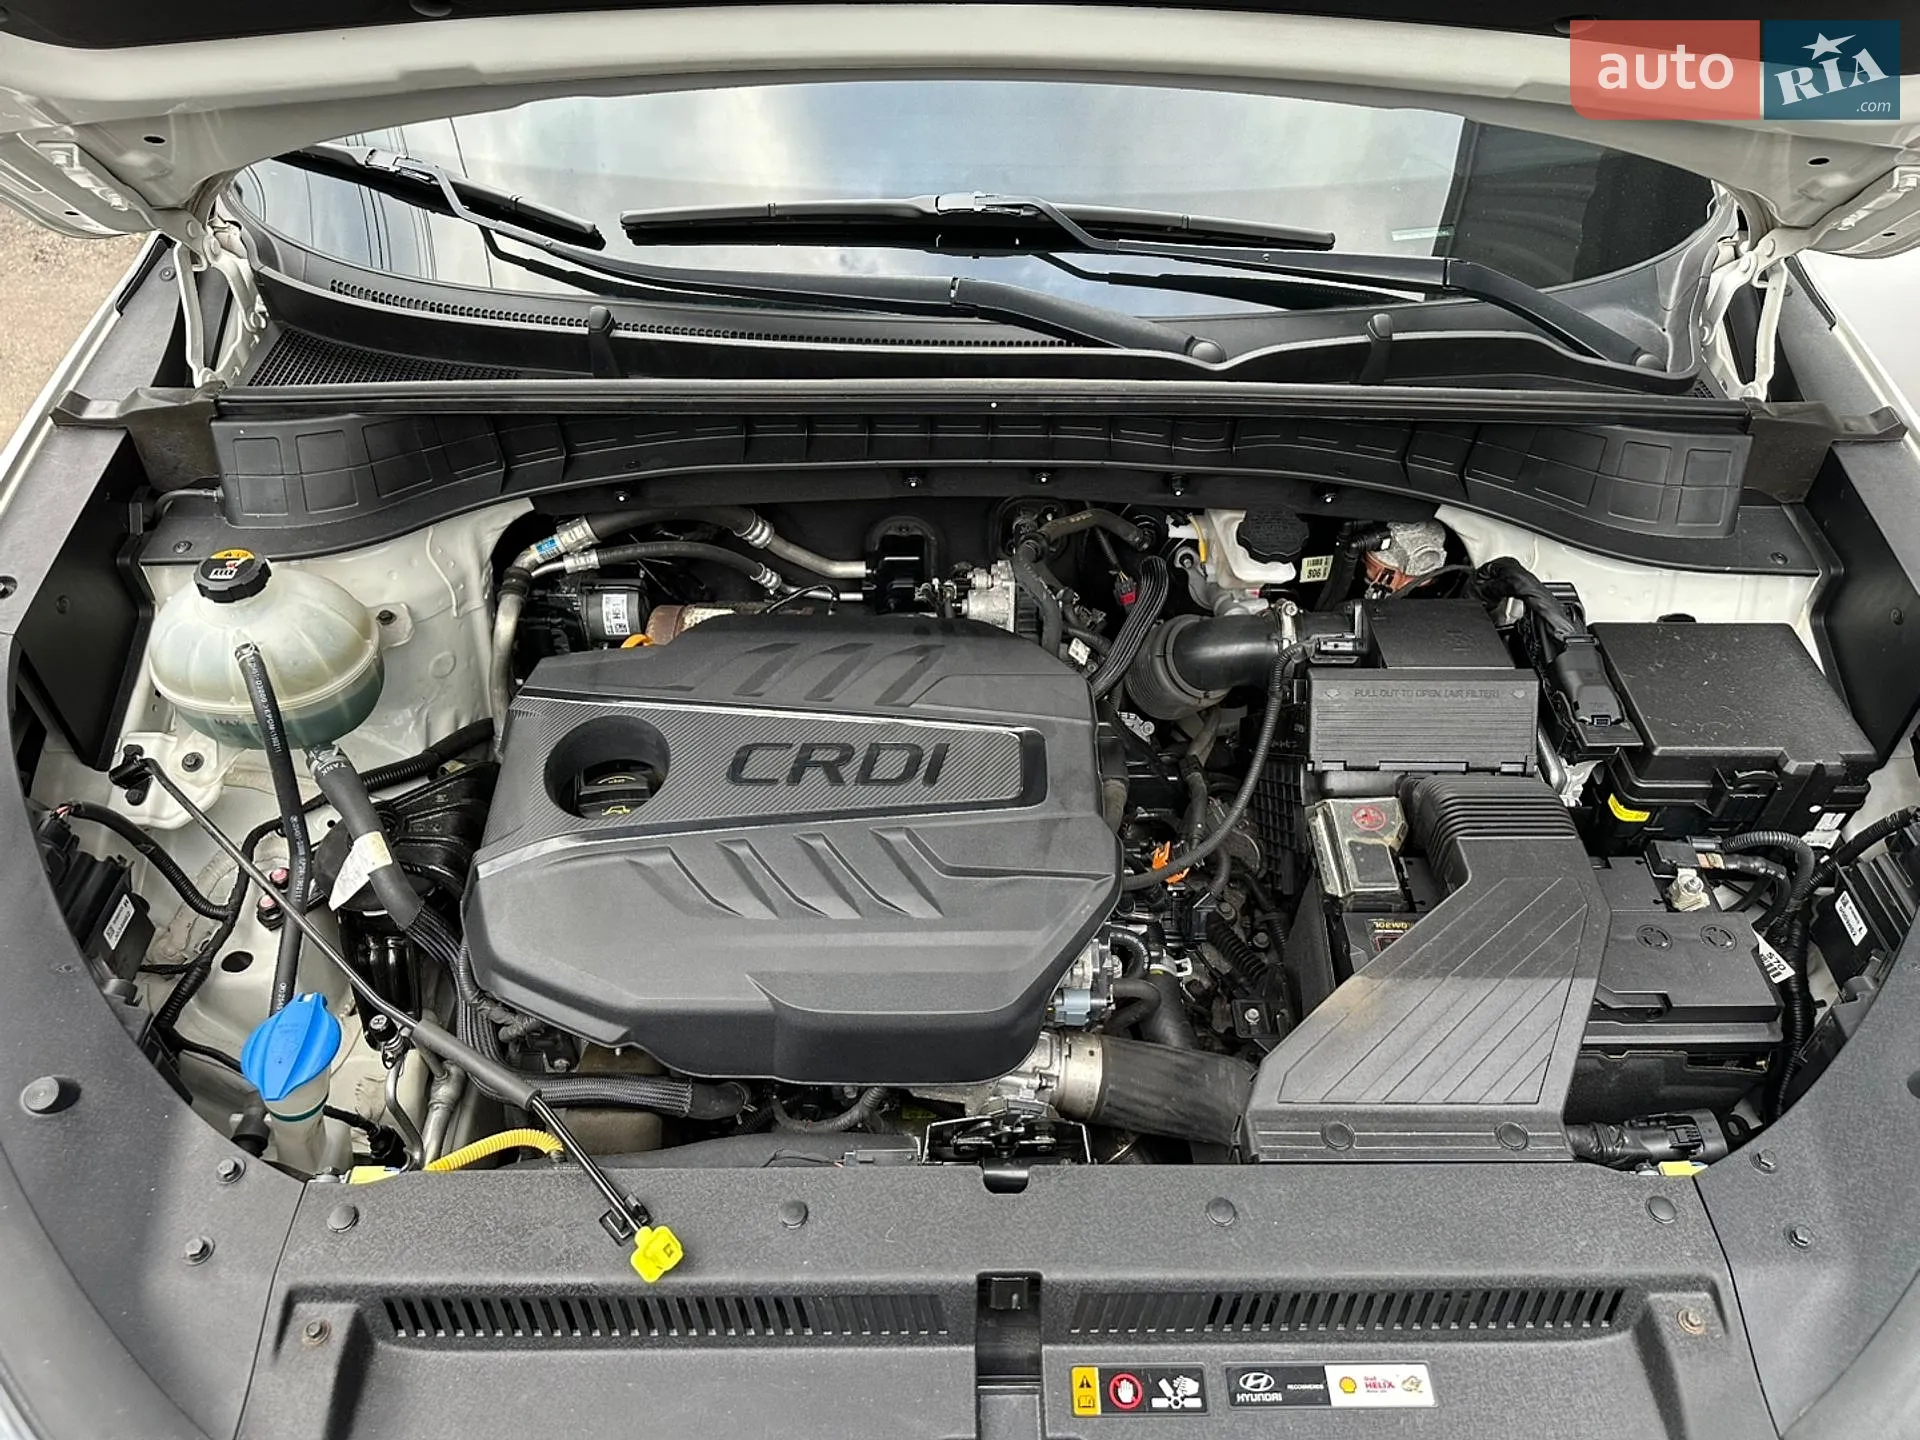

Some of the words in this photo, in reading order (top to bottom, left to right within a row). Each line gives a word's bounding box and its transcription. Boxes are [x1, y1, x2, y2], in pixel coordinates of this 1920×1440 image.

[1354, 689, 1378, 697] PULL
[1379, 689, 1399, 697] OUT
[321, 762, 347, 777] TANK
[726, 742, 950, 787] CRDI
[1236, 1392, 1283, 1402] HYUNDAI
